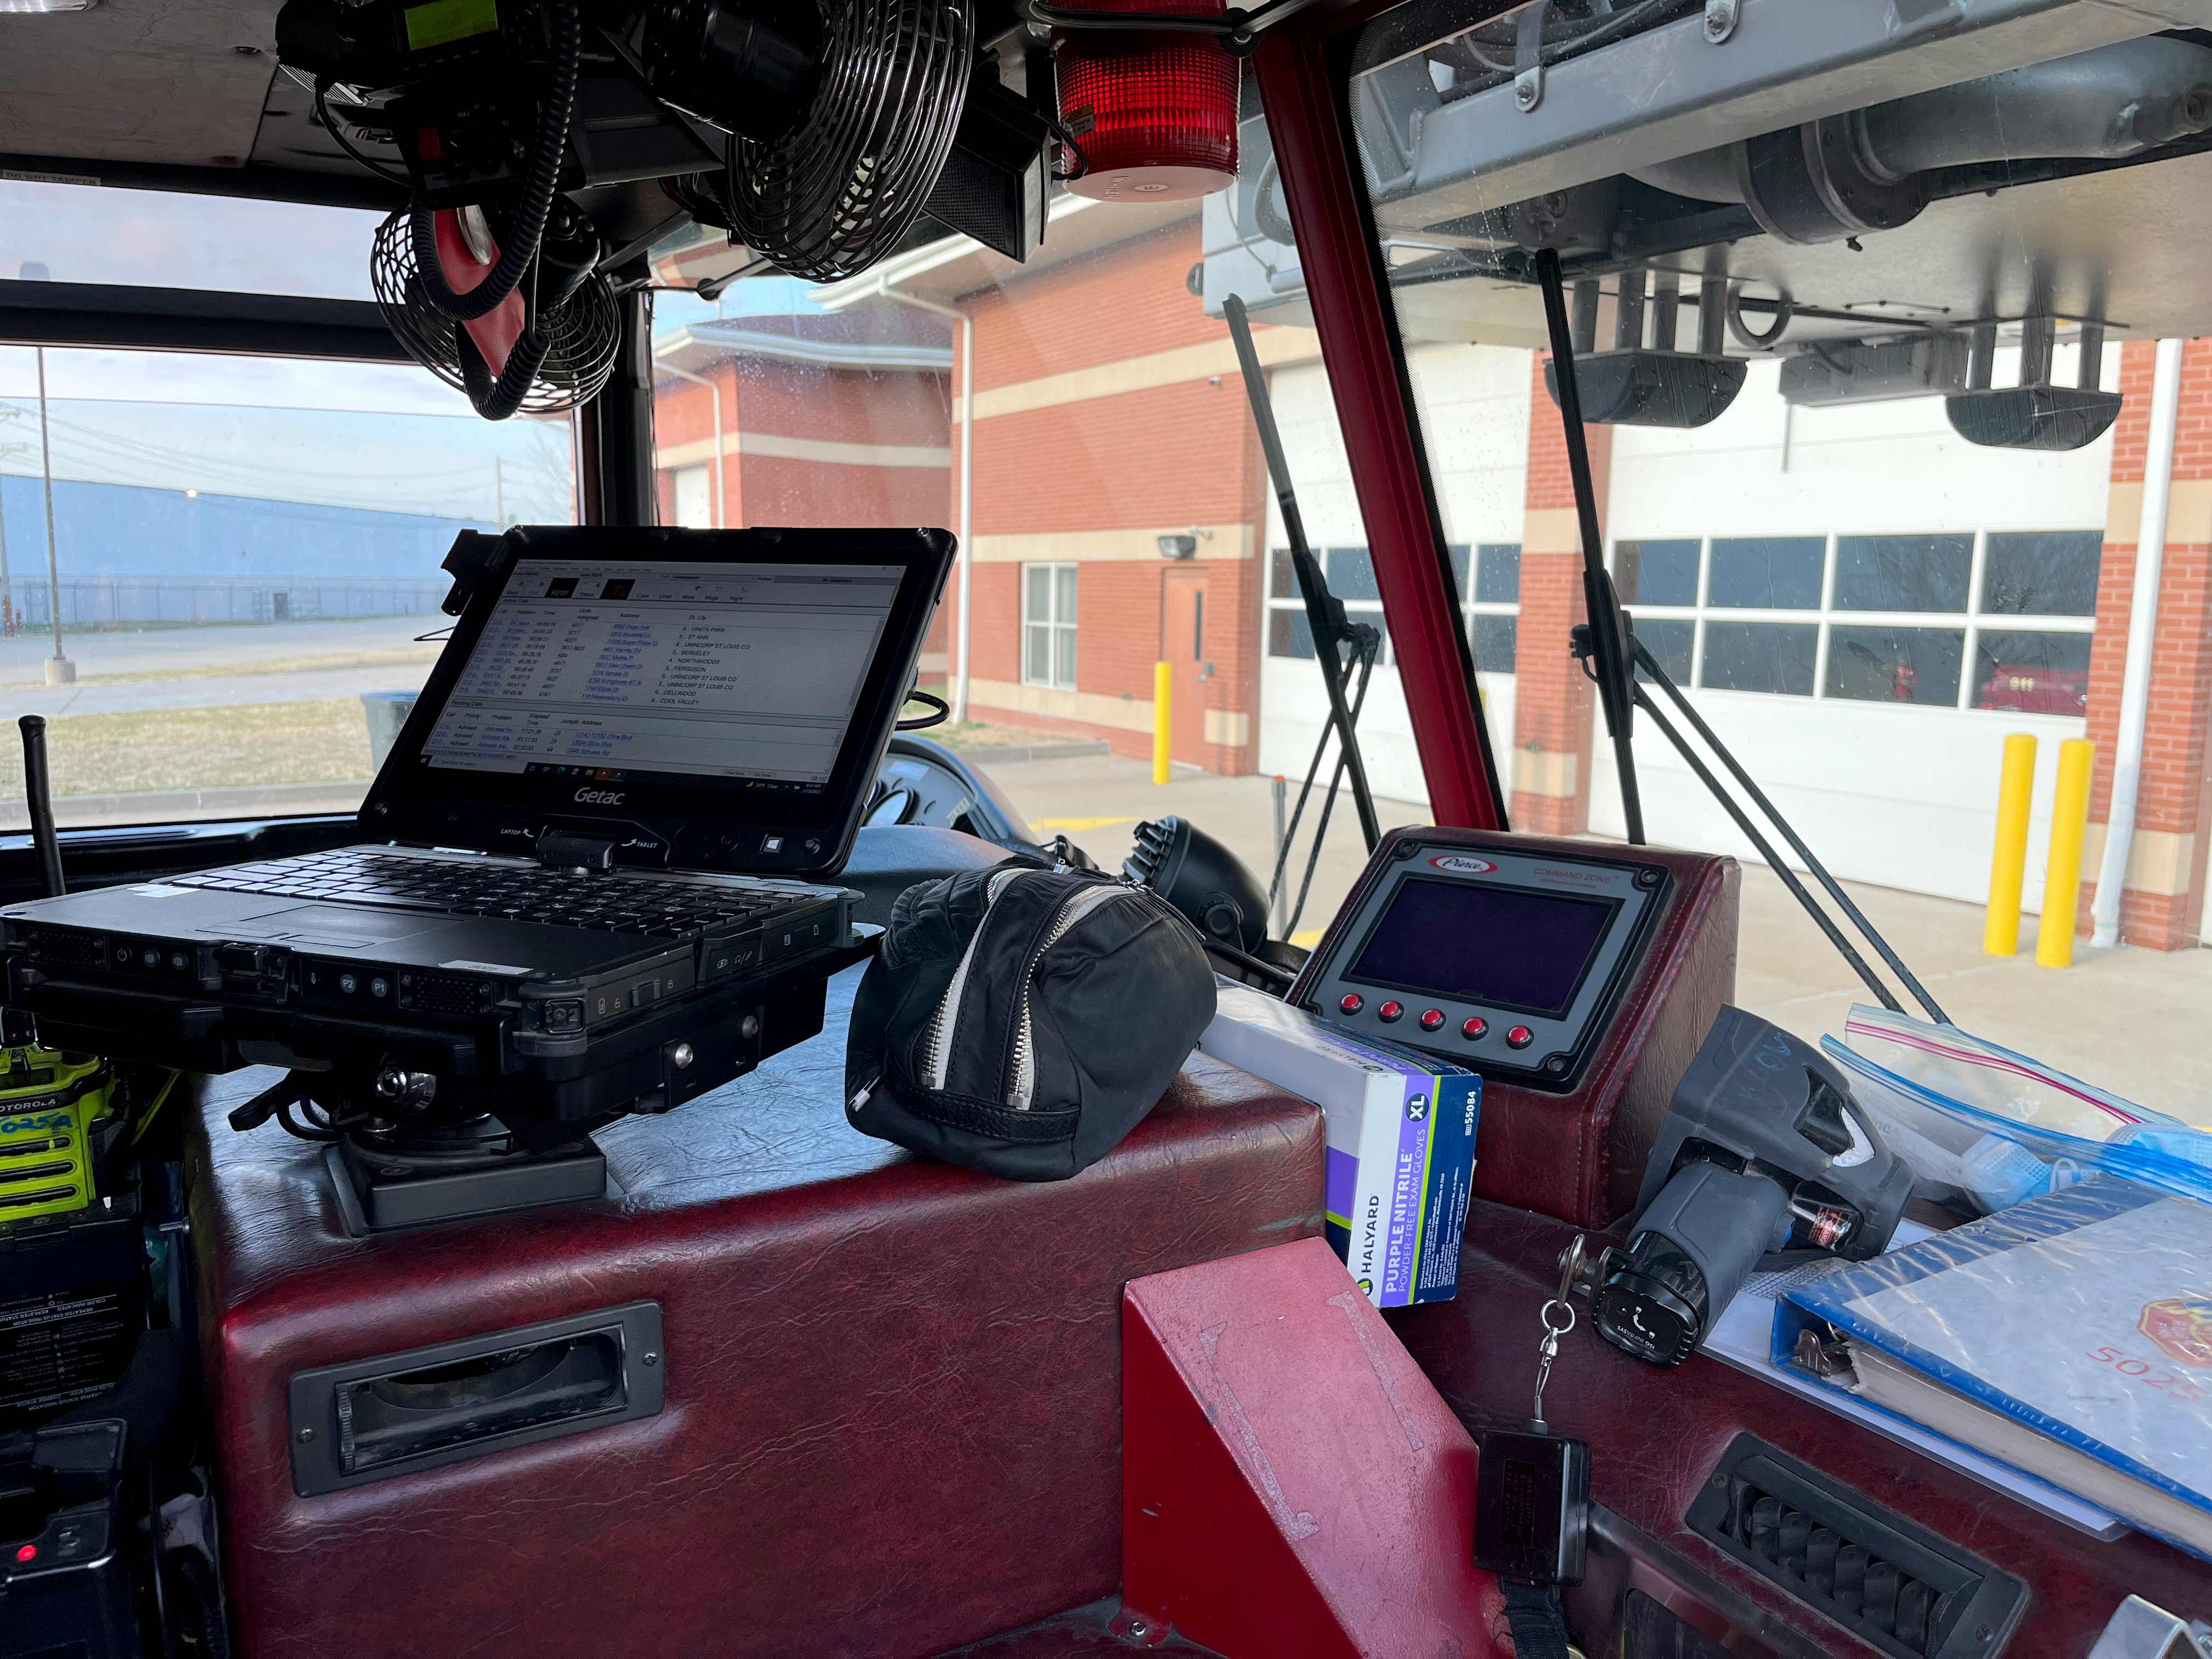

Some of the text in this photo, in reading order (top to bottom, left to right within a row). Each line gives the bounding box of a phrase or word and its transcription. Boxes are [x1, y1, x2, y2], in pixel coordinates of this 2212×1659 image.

[574, 787, 625, 806] Getac
[1442, 857, 1481, 869] Pierce
[1534, 868, 1582, 879] COMMAND
[1584, 873, 1611, 883] ZONE
[342, 978, 353, 988] P2
[374, 982, 385, 992] P1
[0, 1098, 56, 1113] OTOROLA
[1409, 1094, 1426, 1120] XL
[1464, 1090, 1476, 1124] 55084
[1398, 1128, 1426, 1292] POWDER-FREE EXAM GLOVES
[1360, 1194, 1380, 1274] HALYARD
[1385, 1224, 1405, 1293] PURPLE
[20, 1309, 49, 1318] REPEATER
[57, 1302, 86, 1311] INDICATED
[13, 1307, 93, 1326] REPEATER STATUS INDICATOR
[1617, 1325, 1655, 1350] ISG INFRASYS
[2084, 1346, 2209, 1402] 5025
[29, 1401, 58, 1410] INDICATOR
